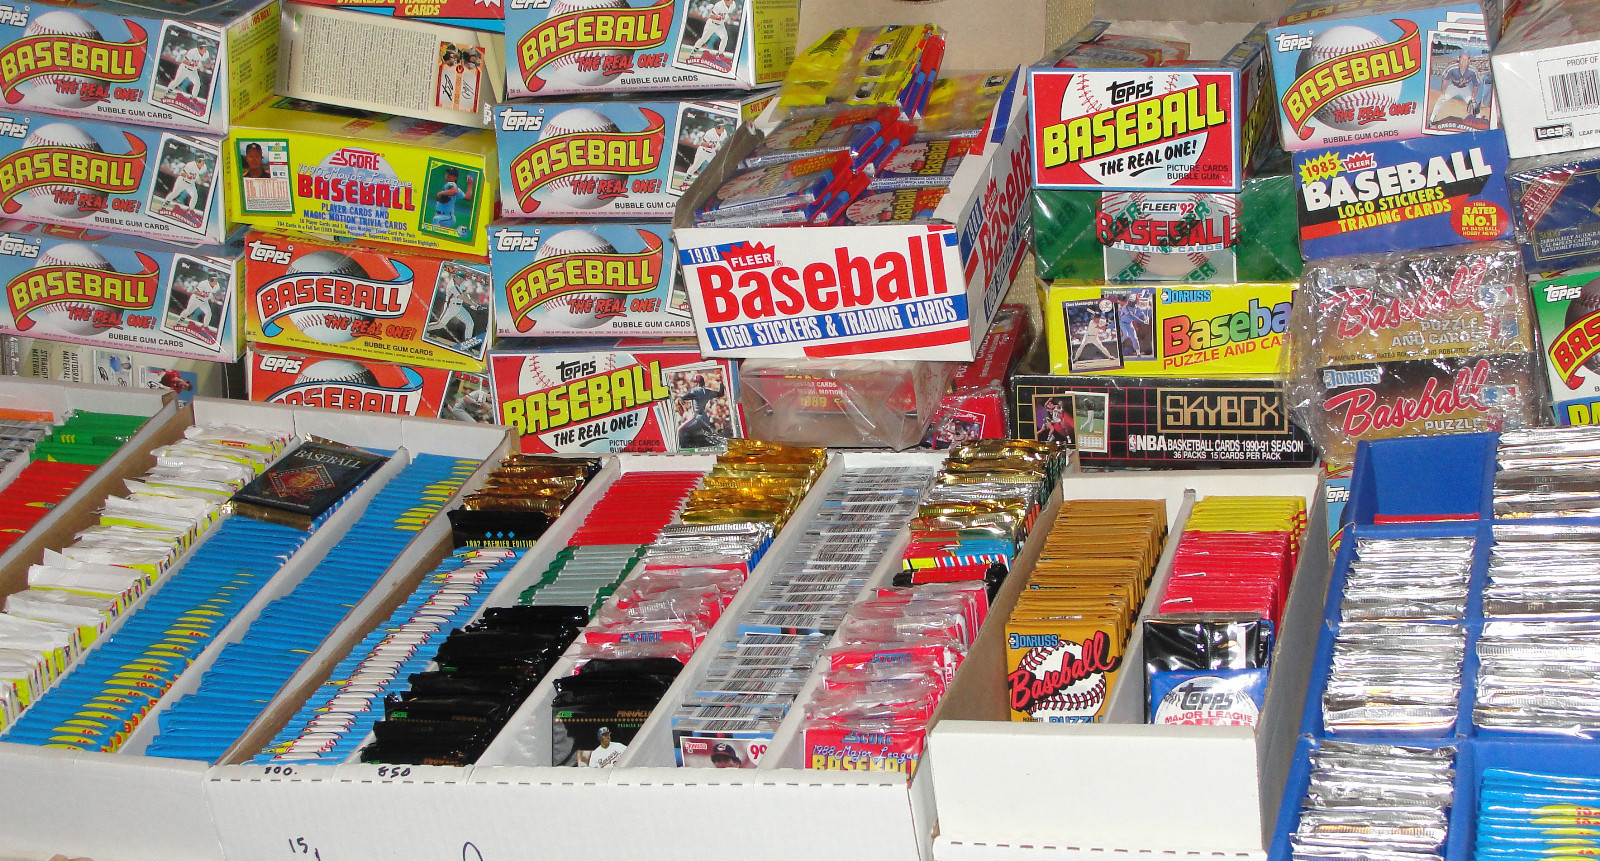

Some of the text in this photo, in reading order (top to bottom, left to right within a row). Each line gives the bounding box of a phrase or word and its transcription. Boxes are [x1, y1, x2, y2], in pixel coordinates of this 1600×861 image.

[404, 5, 440, 16] CARDS
[522, 13, 665, 71] BASEBALL
[1, 40, 137, 83] BASEBALL
[620, 77, 650, 85] BUBBLE
[1286, 51, 1417, 123] BASEBALL
[97, 106, 173, 120] BUBBLE GUM CARDS
[1043, 82, 1226, 168] BASEBALL
[1323, 130, 1399, 144] BUBBLE GUM CARDS
[329, 148, 380, 171] SCORE
[516, 139, 655, 193] BASEBALL
[1100, 140, 1197, 177] THE REAL ONE!
[1166, 164, 1200, 172] PICTURE
[1306, 157, 1371, 178] 1985 FLEER
[0, 151, 135, 193] BASEBALL
[298, 163, 413, 190] 1990 Major League
[1167, 172, 1220, 180] BUBBLE GUM
[1302, 147, 1492, 212] BASEBALL
[297, 173, 416, 212] BASEBALL
[572, 179, 663, 195] THE REAL ONE!
[321, 202, 390, 219] PLAYER CARDS AND
[1142, 203, 1177, 212] FLEER
[1338, 186, 1445, 220] LOGO STICKERS
[1463, 206, 1497, 215] RATED
[303, 209, 408, 231] MAGIC MOTION TRIVIA CARDS
[1338, 199, 1452, 232] TRADING CARDS
[1095, 209, 1238, 250] BASEBALL
[688, 246, 773, 268] 1988 FLEER
[1116, 242, 1223, 252] TRADING CARDS
[511, 258, 654, 312] BASEBALL
[697, 232, 948, 324] Baseball
[12, 271, 149, 311] BASEBALL
[261, 277, 402, 320] BASEBALL
[1162, 290, 1211, 304] DONRUSS
[1319, 259, 1488, 341] Baseball
[568, 298, 662, 314] THE REAL ONE!
[67, 306, 156, 329] THE REAL ONE!
[325, 314, 417, 341] THE REAL ONE!
[645, 320, 664, 328] GUM
[665, 320, 691, 328] CARDS
[713, 298, 958, 349] LOGO STICKERS & TRADING CARDS
[1421, 318, 1480, 332] PUZZLE
[108, 333, 184, 348] BUBBLE GUM CARDS
[364, 340, 434, 357] BUBBLE GUM CARDS
[1391, 331, 1483, 348] AND CARDS
[1163, 349, 1219, 370] PUZZLE
[1223, 342, 1257, 358] AND
[1323, 369, 1382, 388] DONRUSS
[503, 360, 669, 437] BASEBALL
[1323, 359, 1491, 437] Baseball
[1166, 395, 1279, 426] SKYBOX
[553, 412, 639, 447] THE REAL ONE!
[1424, 417, 1483, 432] PUZZLE
[1137, 435, 1303, 452] NBA BASKETBALL CARDS 1990-91 SEASON
[294, 450, 361, 469] BASEBALL
[1173, 451, 1281, 460] 36 PACKS 15 CARDS PER PACK
[1009, 633, 1059, 649] DONRUSS
[1008, 629, 1121, 711] Baseball
[1165, 710, 1253, 724] MAJOR LEAGUE
[842, 731, 893, 745] SCORE
[813, 745, 918, 764] 1988 Major League
